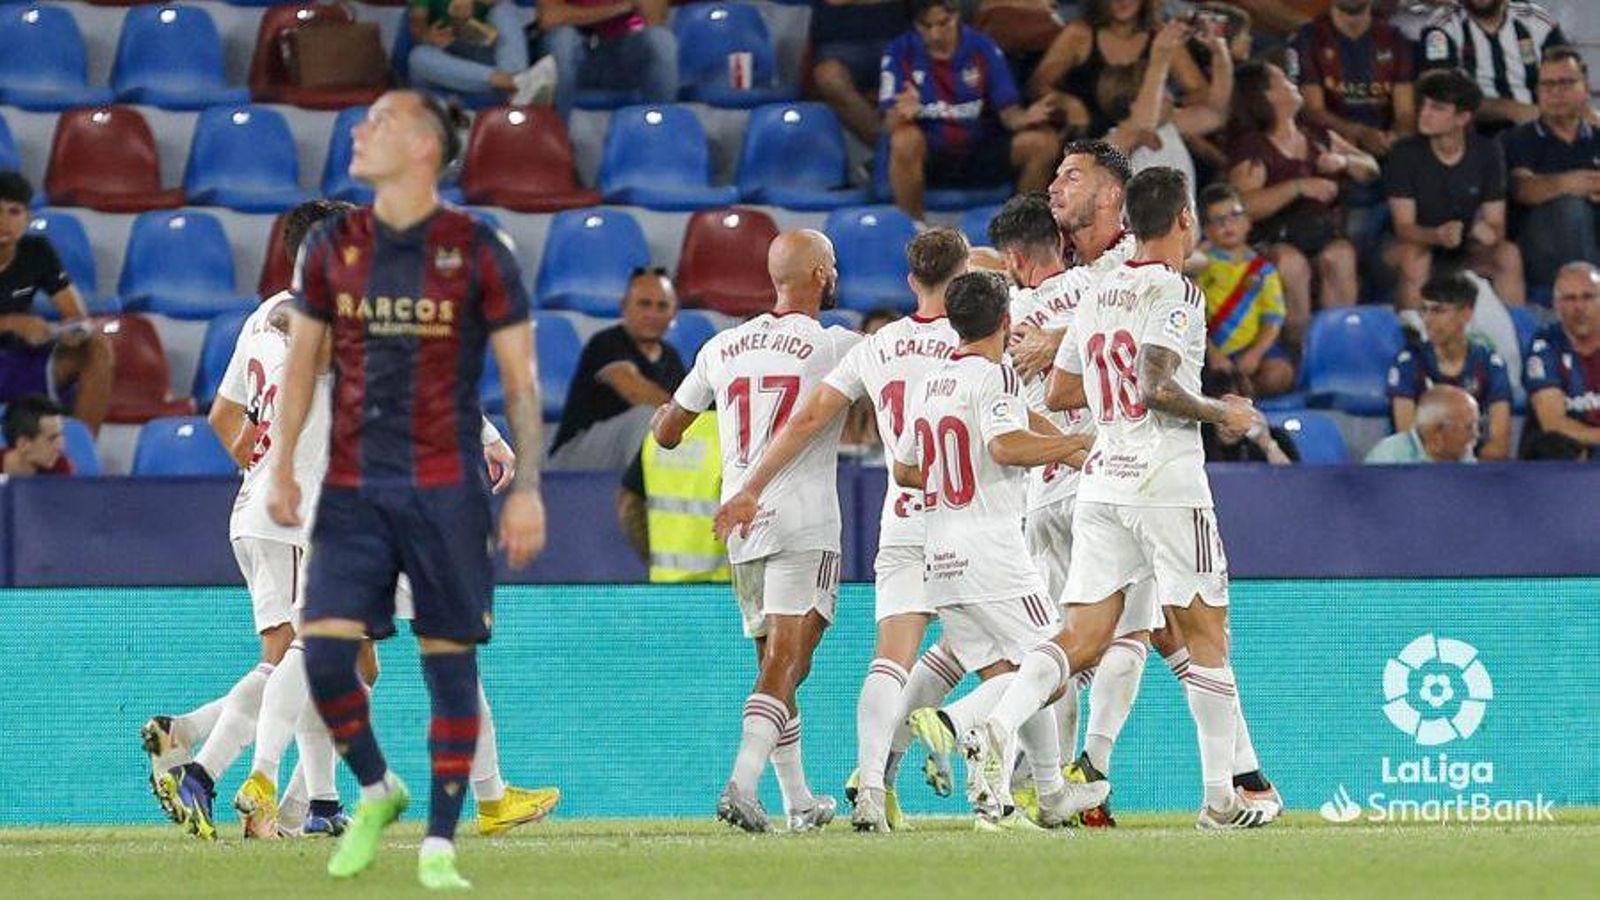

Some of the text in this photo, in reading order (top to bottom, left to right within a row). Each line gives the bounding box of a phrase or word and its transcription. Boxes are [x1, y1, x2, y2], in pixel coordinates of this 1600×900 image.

[720, 333, 814, 362] MIKEL RICO
[1086, 329, 1149, 420] 18
[725, 375, 801, 468] 17
[914, 415, 975, 510] 20
